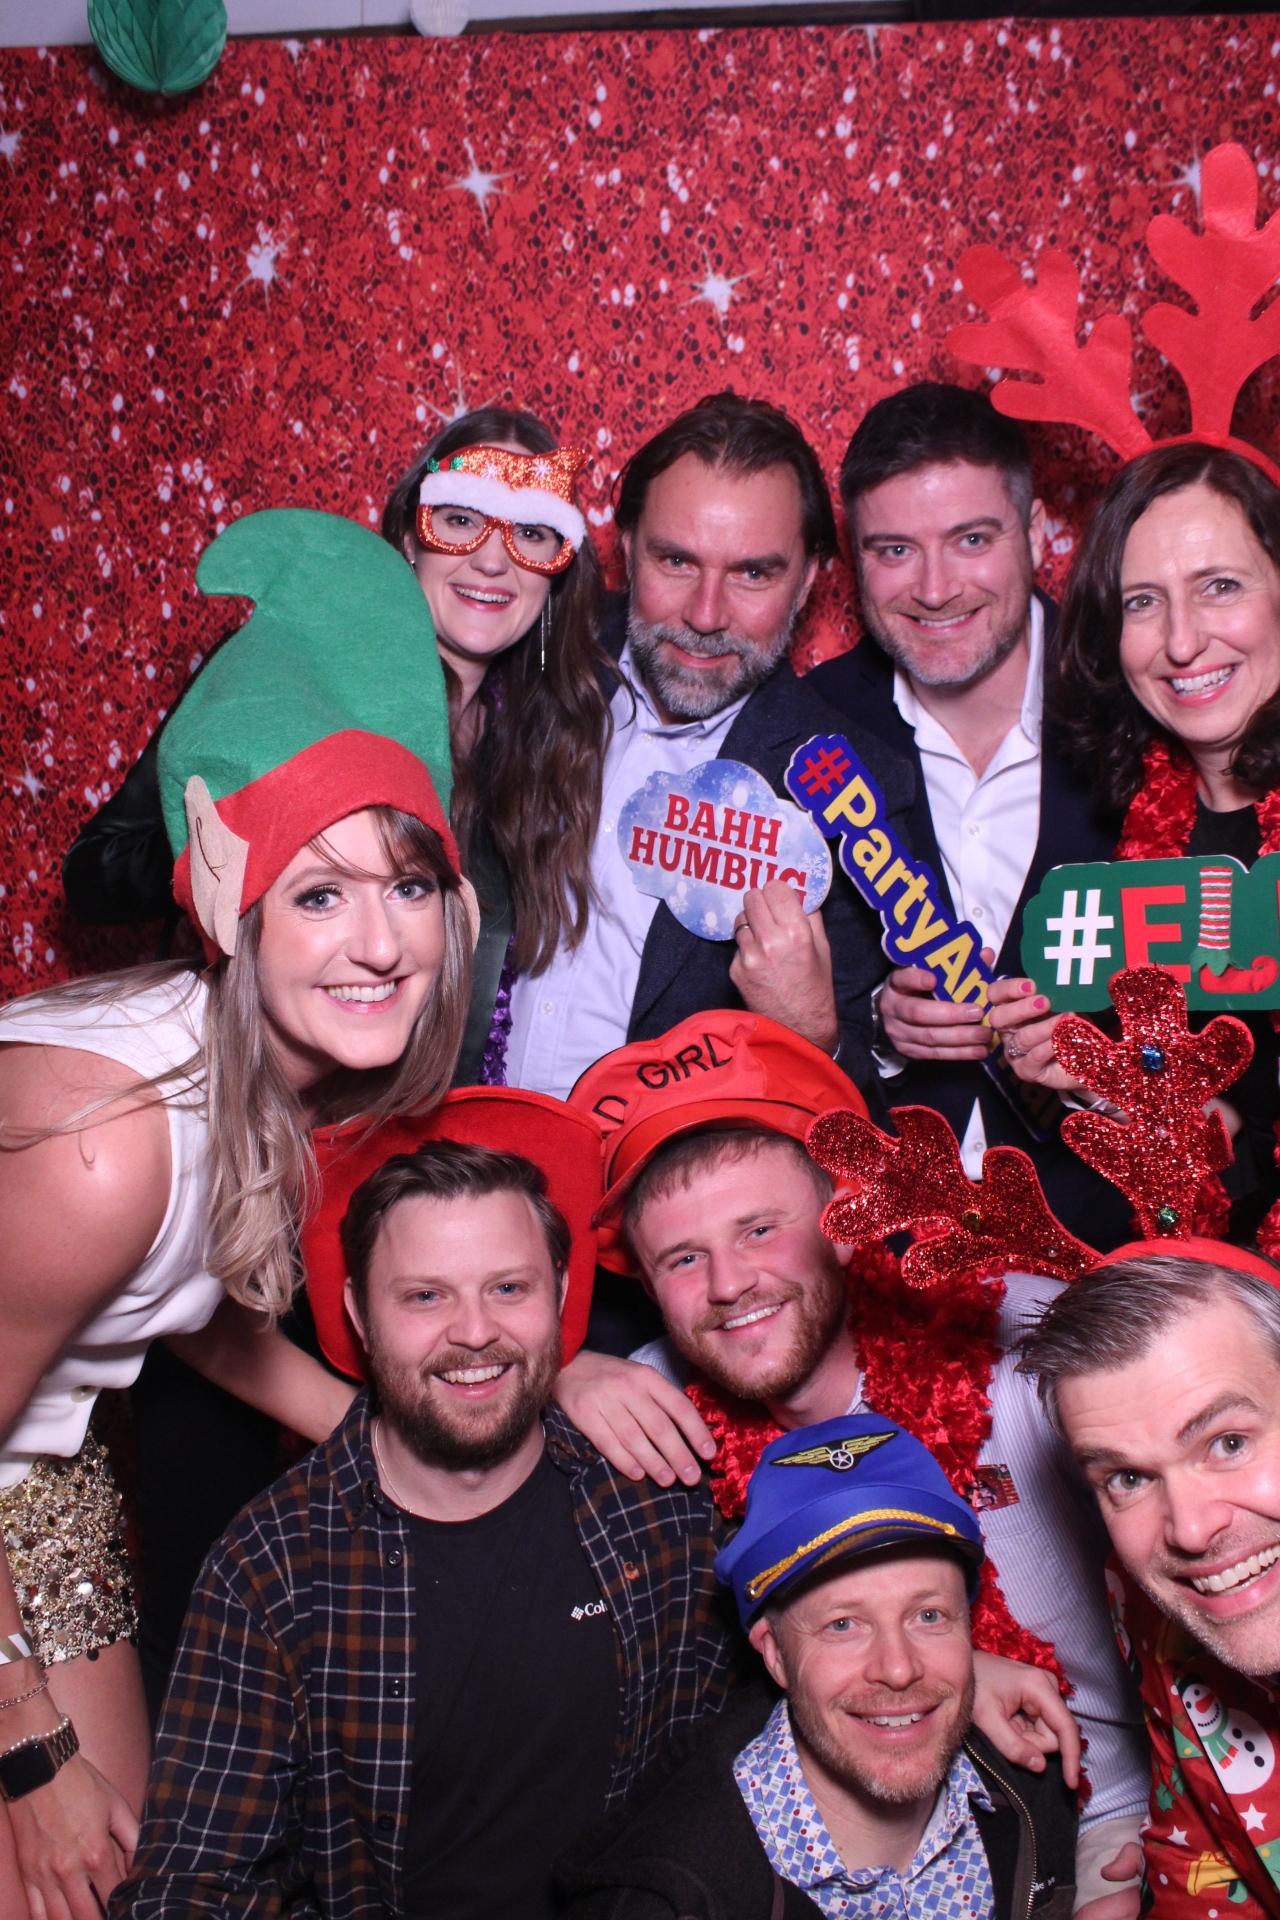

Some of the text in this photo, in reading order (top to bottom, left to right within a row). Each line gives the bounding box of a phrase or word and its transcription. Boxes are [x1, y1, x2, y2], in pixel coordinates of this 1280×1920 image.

[663, 793, 782, 857] BAHH
[636, 1033, 732, 1090] GIRL
[584, 1599, 608, 1617] Col
